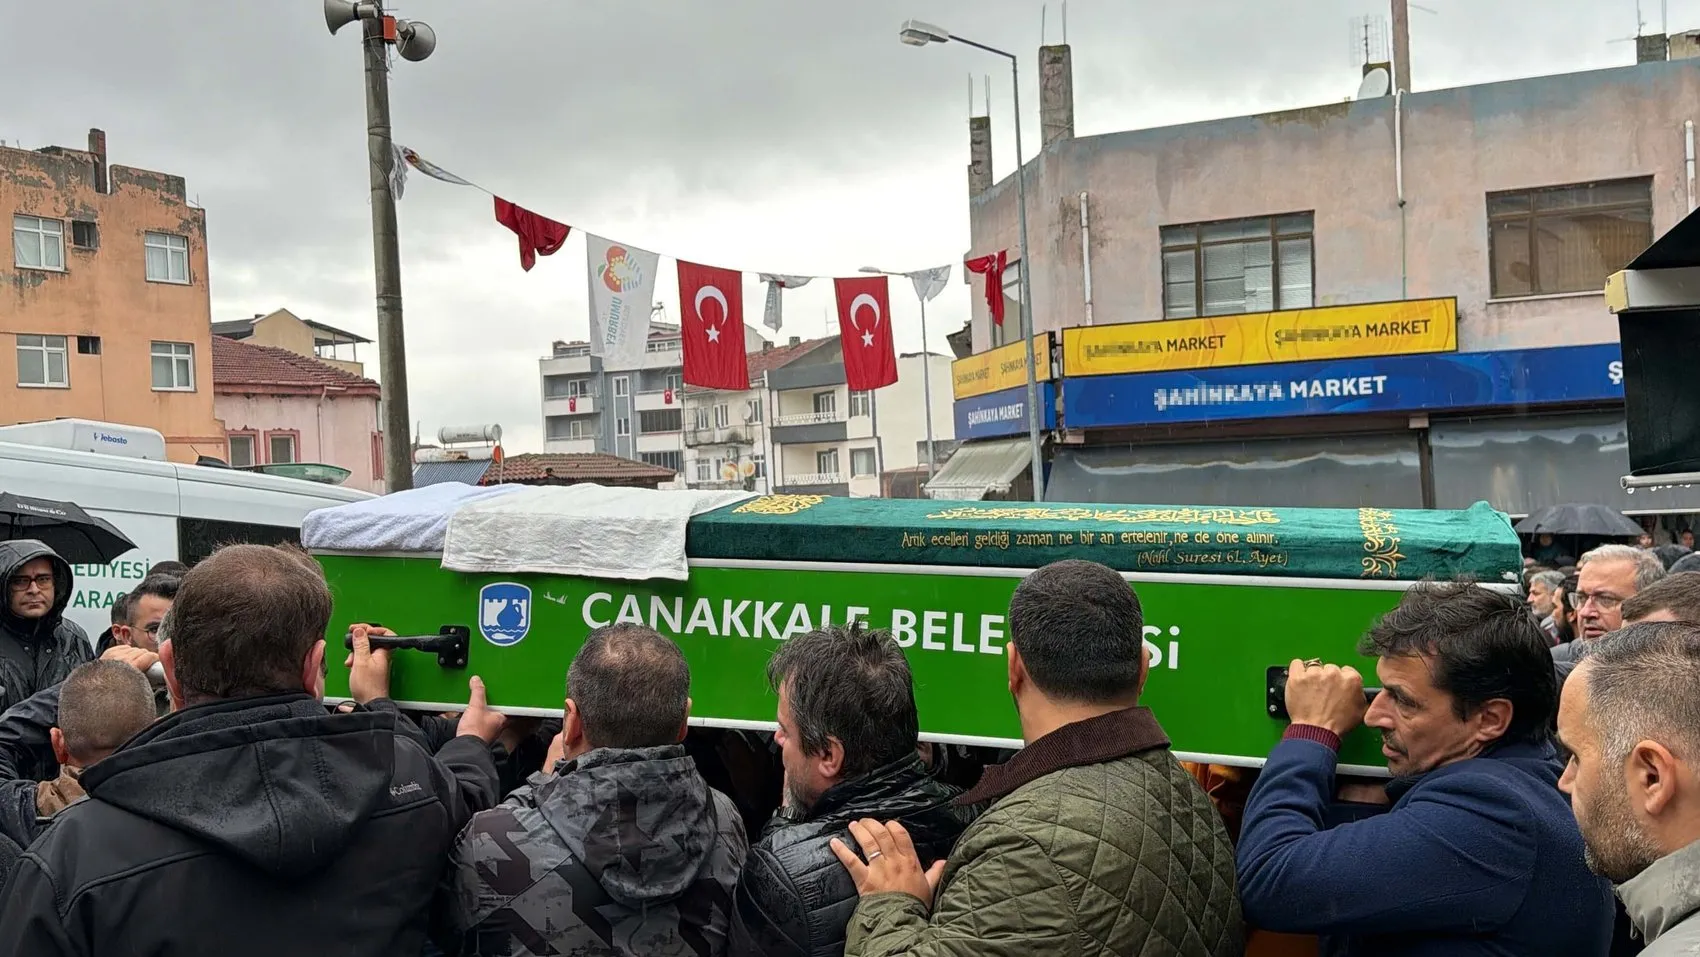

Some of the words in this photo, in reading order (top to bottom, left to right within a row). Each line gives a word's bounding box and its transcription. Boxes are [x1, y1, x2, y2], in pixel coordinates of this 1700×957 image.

[1366, 319, 1431, 338] MARKET
[1166, 335, 1226, 352] MARKET
[1290, 375, 1388, 399] MARKET
[999, 403, 1024, 420] MARKET
[931, 531, 969, 547] ecelleri
[974, 531, 1010, 549] geldiği
[1016, 532, 1053, 546] zaman
[1059, 532, 1073, 545] ne
[1080, 530, 1094, 545] bir
[1100, 533, 1115, 544] an
[1194, 531, 1210, 543] de
[1216, 531, 1239, 543] öne
[1174, 551, 1222, 564] Suresi
[72, 590, 126, 608] ARA
